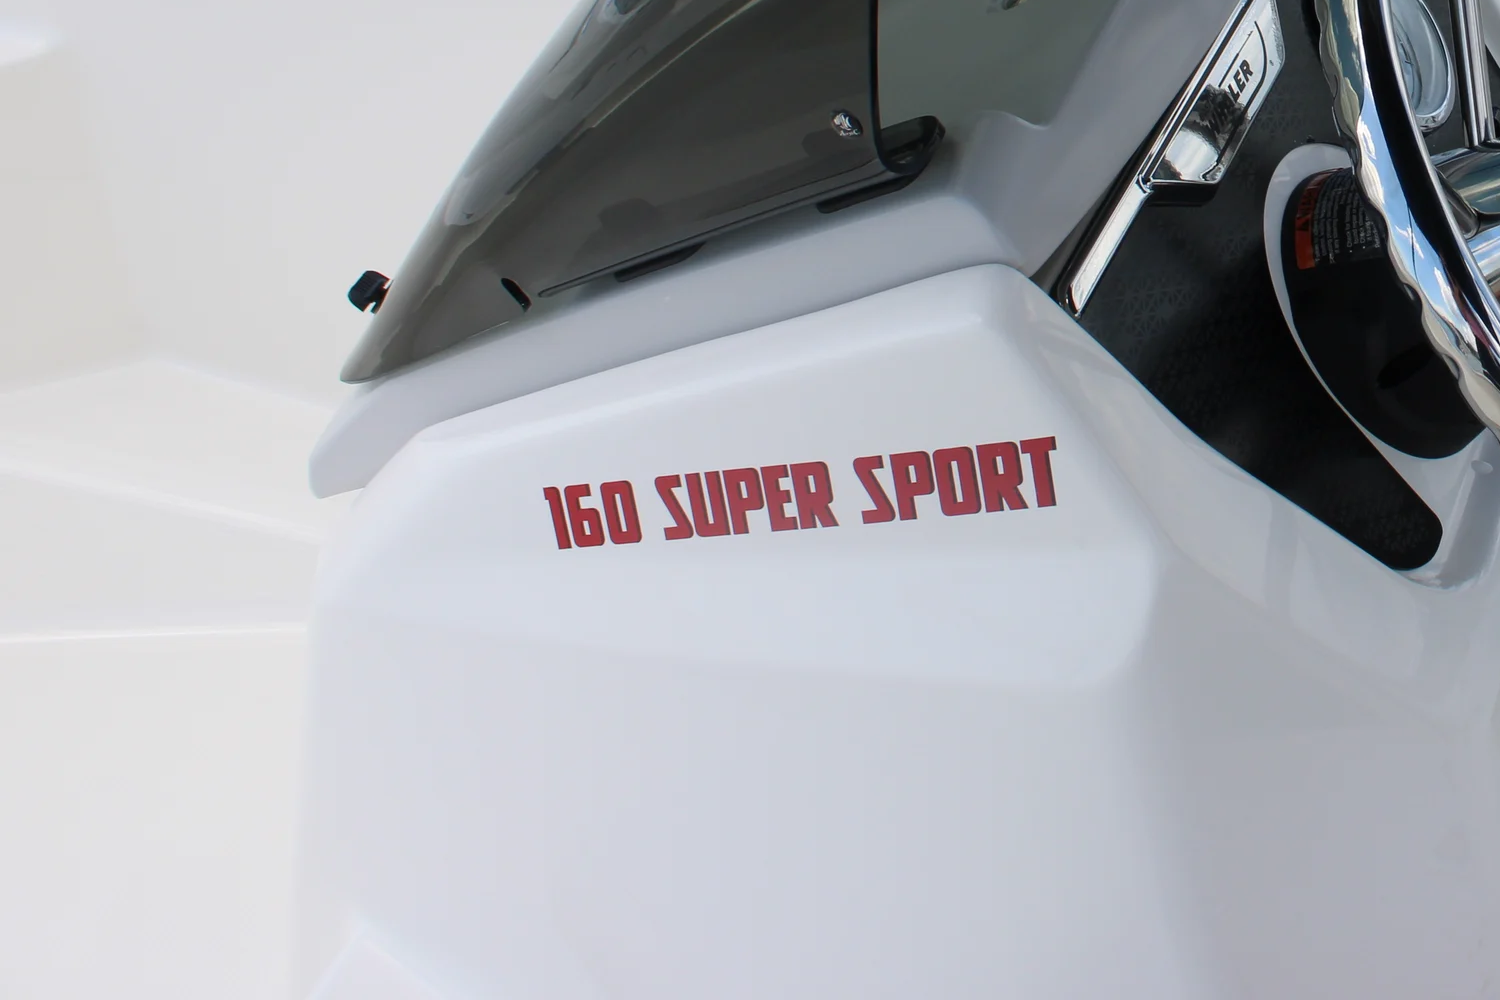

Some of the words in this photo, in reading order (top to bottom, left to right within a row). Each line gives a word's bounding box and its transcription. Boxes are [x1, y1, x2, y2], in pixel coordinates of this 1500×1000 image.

[543, 480, 642, 550] 160
[653, 460, 840, 541] SUPER
[852, 435, 1058, 525] SPORT
